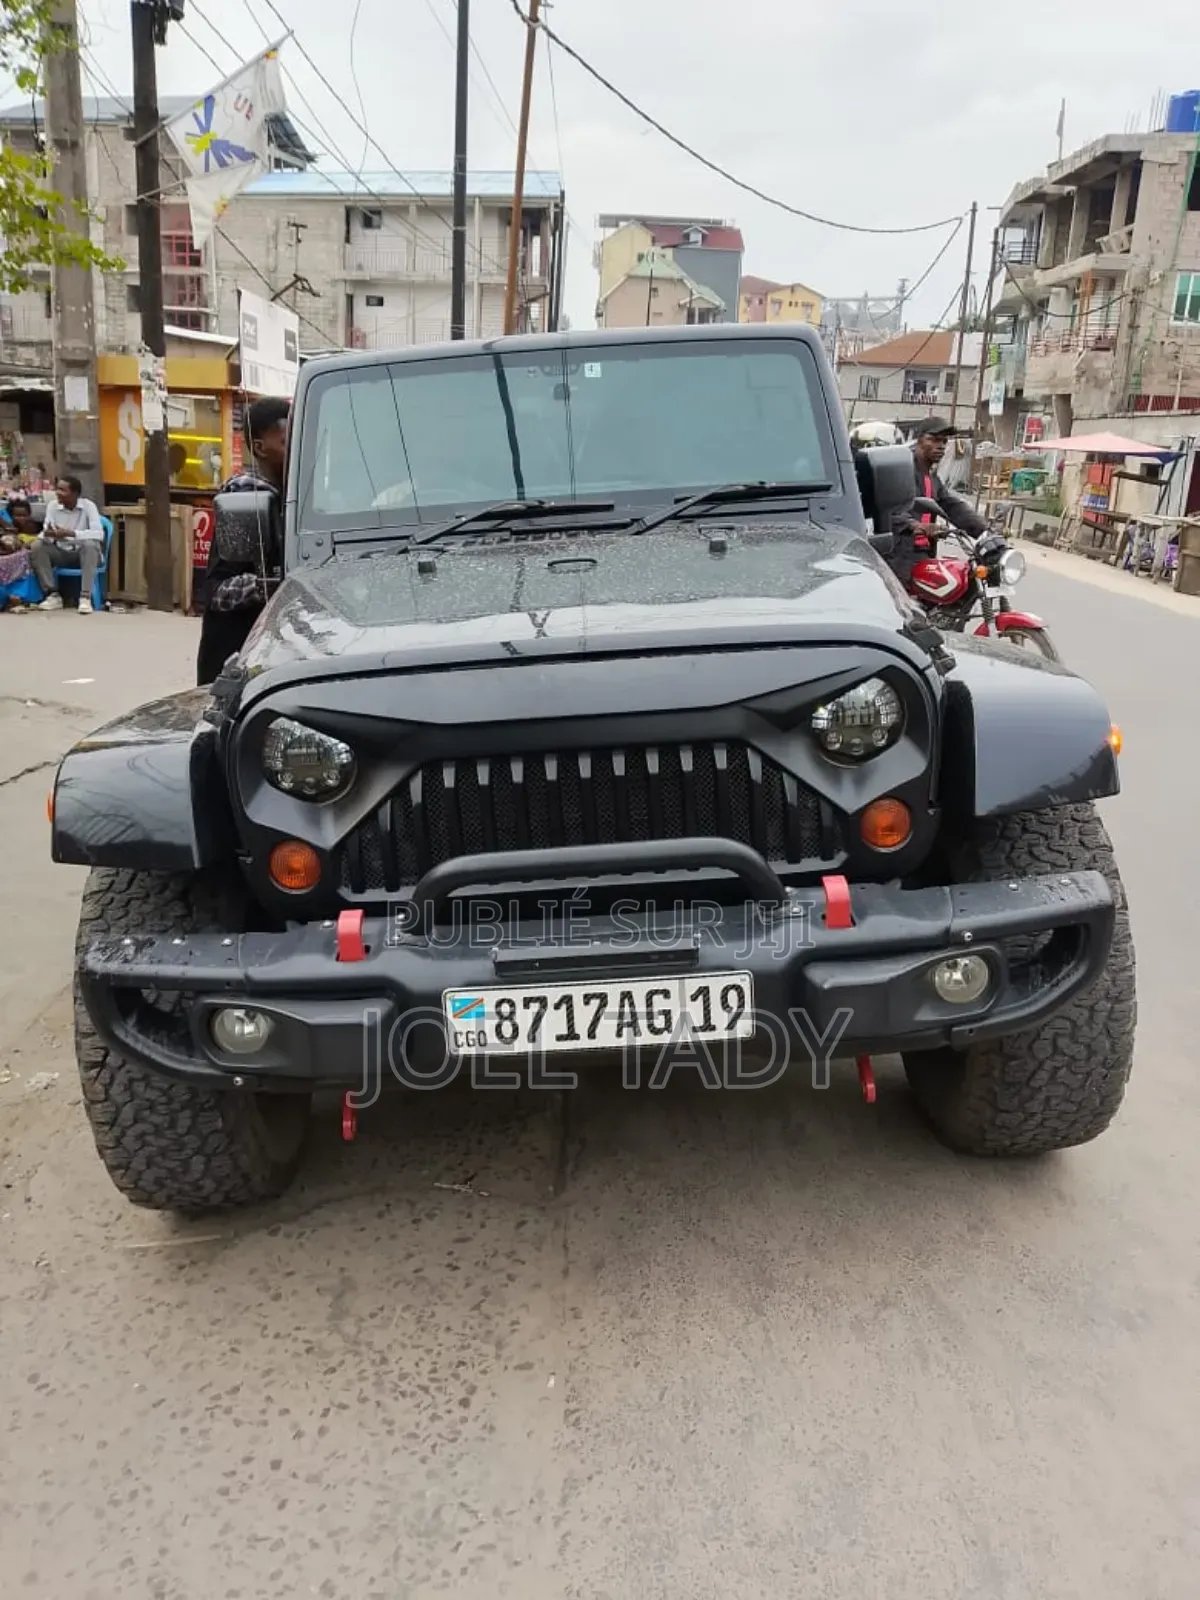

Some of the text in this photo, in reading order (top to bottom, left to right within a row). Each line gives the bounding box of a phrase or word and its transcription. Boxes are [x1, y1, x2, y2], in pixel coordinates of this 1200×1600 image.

[494, 984, 746, 1045] 8717AG 19
[454, 1030, 488, 1048] CGO
